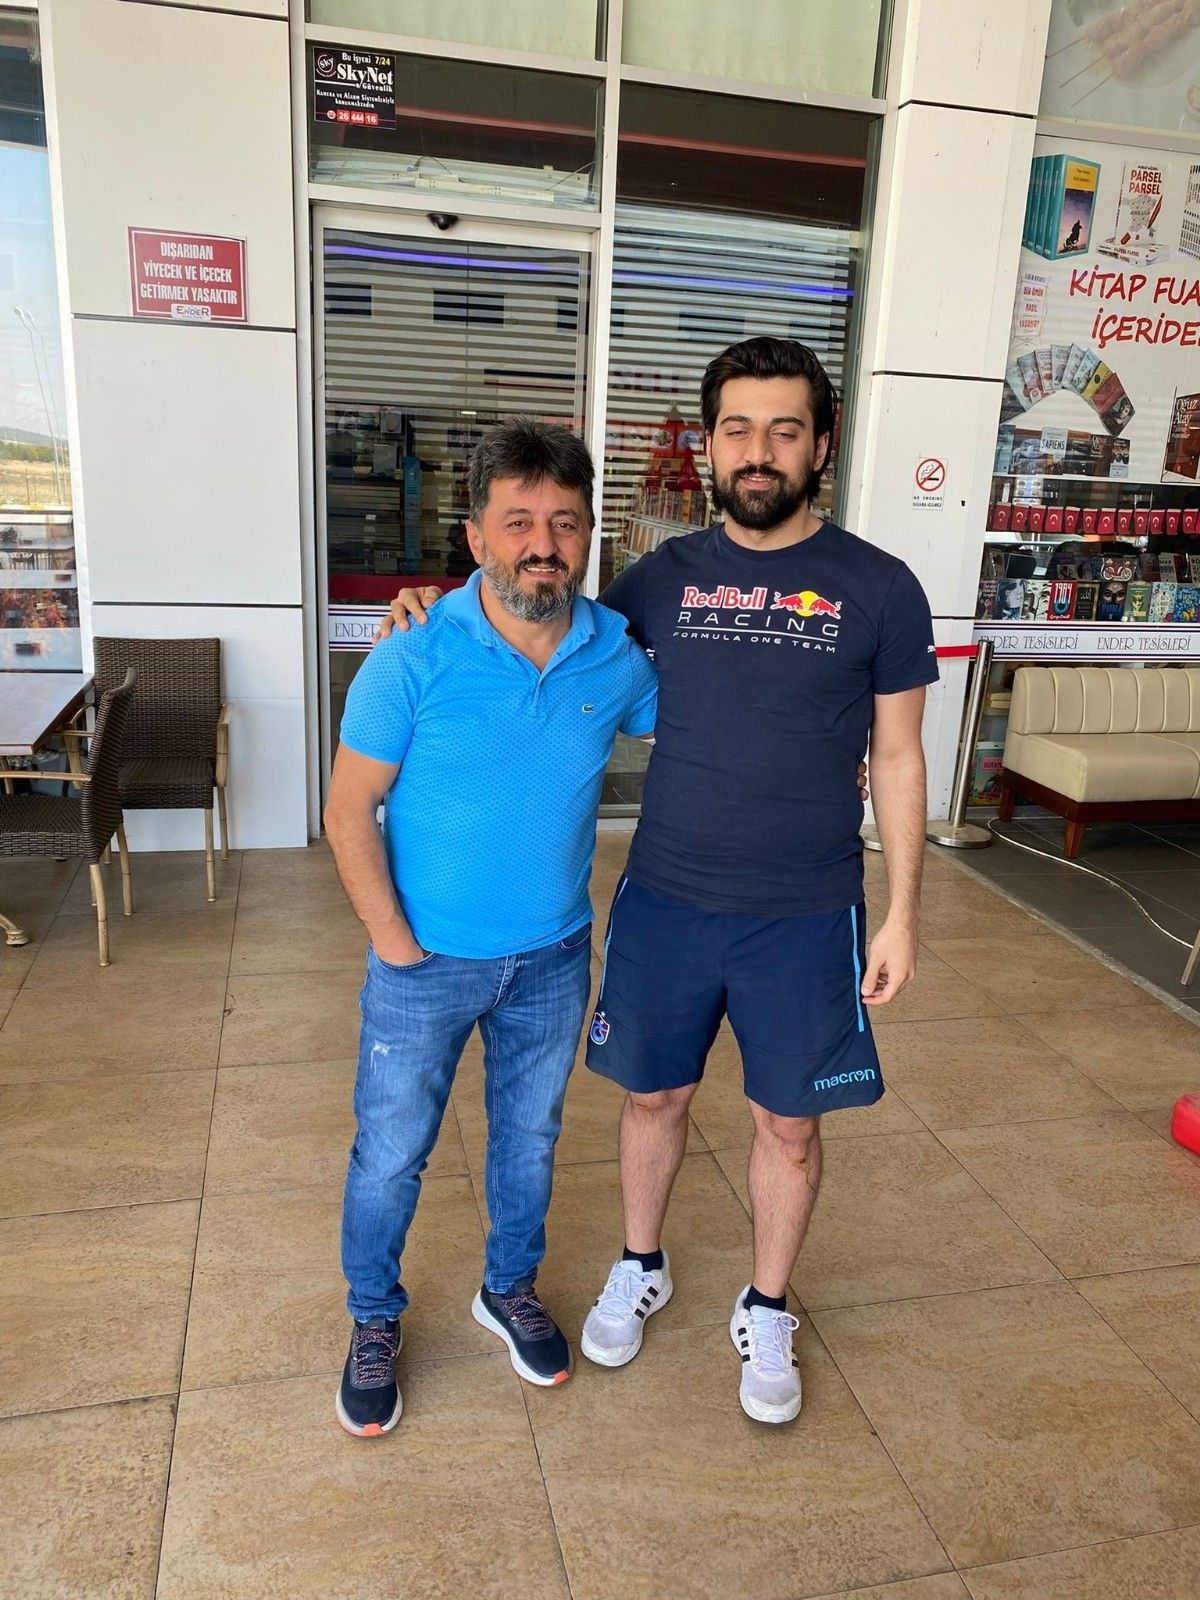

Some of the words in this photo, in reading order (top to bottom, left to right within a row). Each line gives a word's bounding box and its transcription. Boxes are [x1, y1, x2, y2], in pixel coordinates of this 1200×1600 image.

[374, 56, 391, 66] 7/24
[336, 63, 394, 87] SkyNet
[362, 82, 393, 93] Güvenlik
[1130, 169, 1163, 184] PARSEL
[1128, 181, 1161, 195] PARSEL
[160, 241, 214, 260] DIŞARIDAN
[143, 260, 183, 280] YİYECEK
[184, 264, 198, 281] VE
[199, 263, 233, 284] İÇECEK
[140, 282, 189, 302] GETİRMEK
[191, 287, 238, 305] YASAKTIR
[1069, 264, 1148, 303] KİTAP
[1091, 307, 1200, 350] İÇERİDE
[1175, 397, 1198, 413] Oğuz
[1173, 411, 1192, 426] Atay
[1041, 438, 1066, 451] SAPIENS
[681, 585, 724, 608] Red
[722, 586, 768, 610] Bull
[1053, 582, 1073, 604] 1984
[677, 611, 839, 638] RACING
[672, 631, 741, 642] FORMULA
[750, 636, 782, 645] ONE
[792, 640, 836, 654] TEAM
[1023, 633, 1079, 650] TESİSLERİ
[1097, 635, 1135, 651] ENDER
[1139, 635, 1191, 651] TESİSLERİ
[814, 1068, 876, 1091] macron
